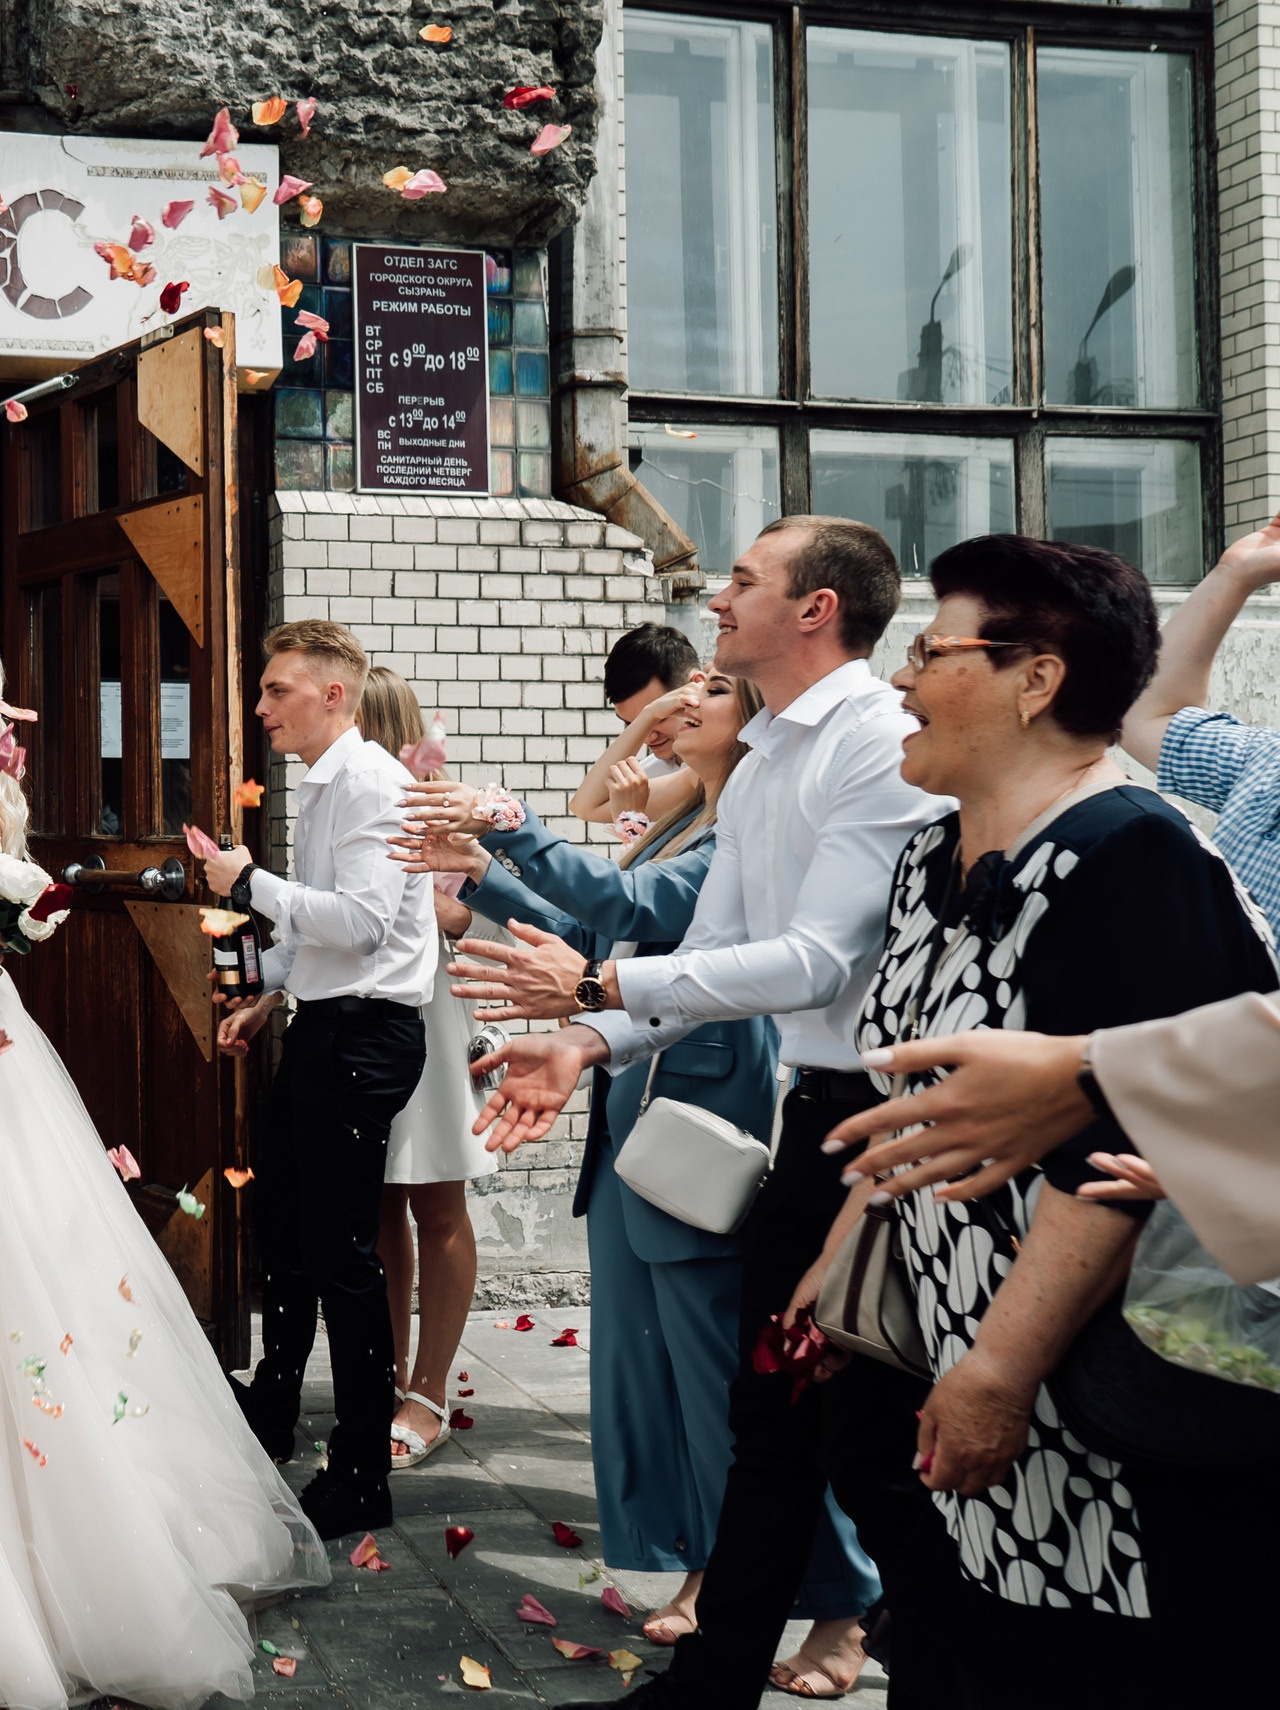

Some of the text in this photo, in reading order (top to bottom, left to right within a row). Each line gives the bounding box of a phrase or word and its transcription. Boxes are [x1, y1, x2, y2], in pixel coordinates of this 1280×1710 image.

[384, 256, 458, 270] ОТДЕЛ ЗАГС
[370, 273, 473, 288] ГОРОДСКОГО ОКРУГА
[398, 287, 446, 297] СЫЗРАНЬ
[373, 301, 471, 316] РЕЖИМ РАБОТЫ
[366, 326, 381, 337] ВТ
[366, 340, 382, 350] СР
[366, 354, 382, 364] ЧТ
[366, 368, 382, 379] ПТ
[366, 383, 384, 393] СБ
[398, 396, 445, 406] ПЕРЕРЫВ
[377, 430, 391, 439] ВС
[378, 441, 391, 450] ПН
[399, 438, 465, 448] ВЫХОДНЫЕ ДНИ
[380, 455, 468, 466] САНИТАРНЫЙ ДЕНЬ
[377, 466, 472, 476] ПОСЛЕДНИЙ ЧЕТВЕРГ
[384, 476, 466, 487] КАЖДОГО МЕСЯЦА
